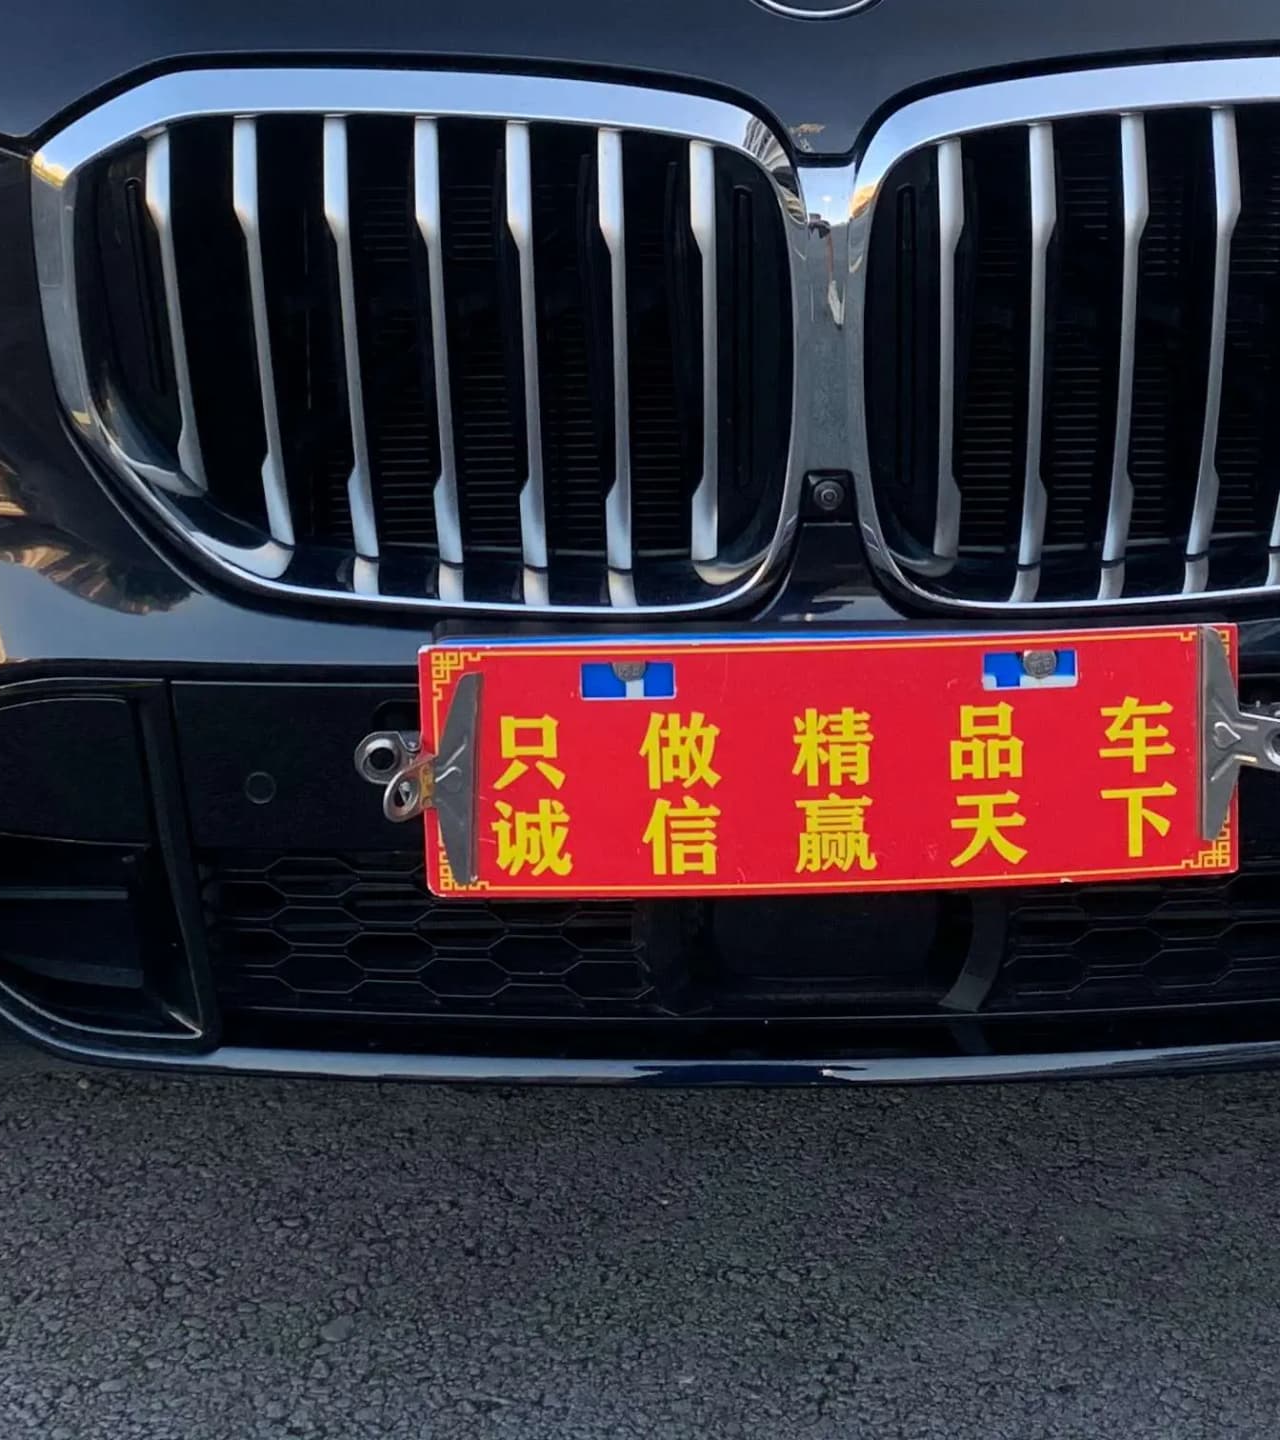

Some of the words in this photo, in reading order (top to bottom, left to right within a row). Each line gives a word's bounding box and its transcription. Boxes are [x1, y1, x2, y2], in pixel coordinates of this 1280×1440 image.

[493, 696, 1176, 791] 只做精品车
[491, 781, 1178, 876] 诚信赢天下
